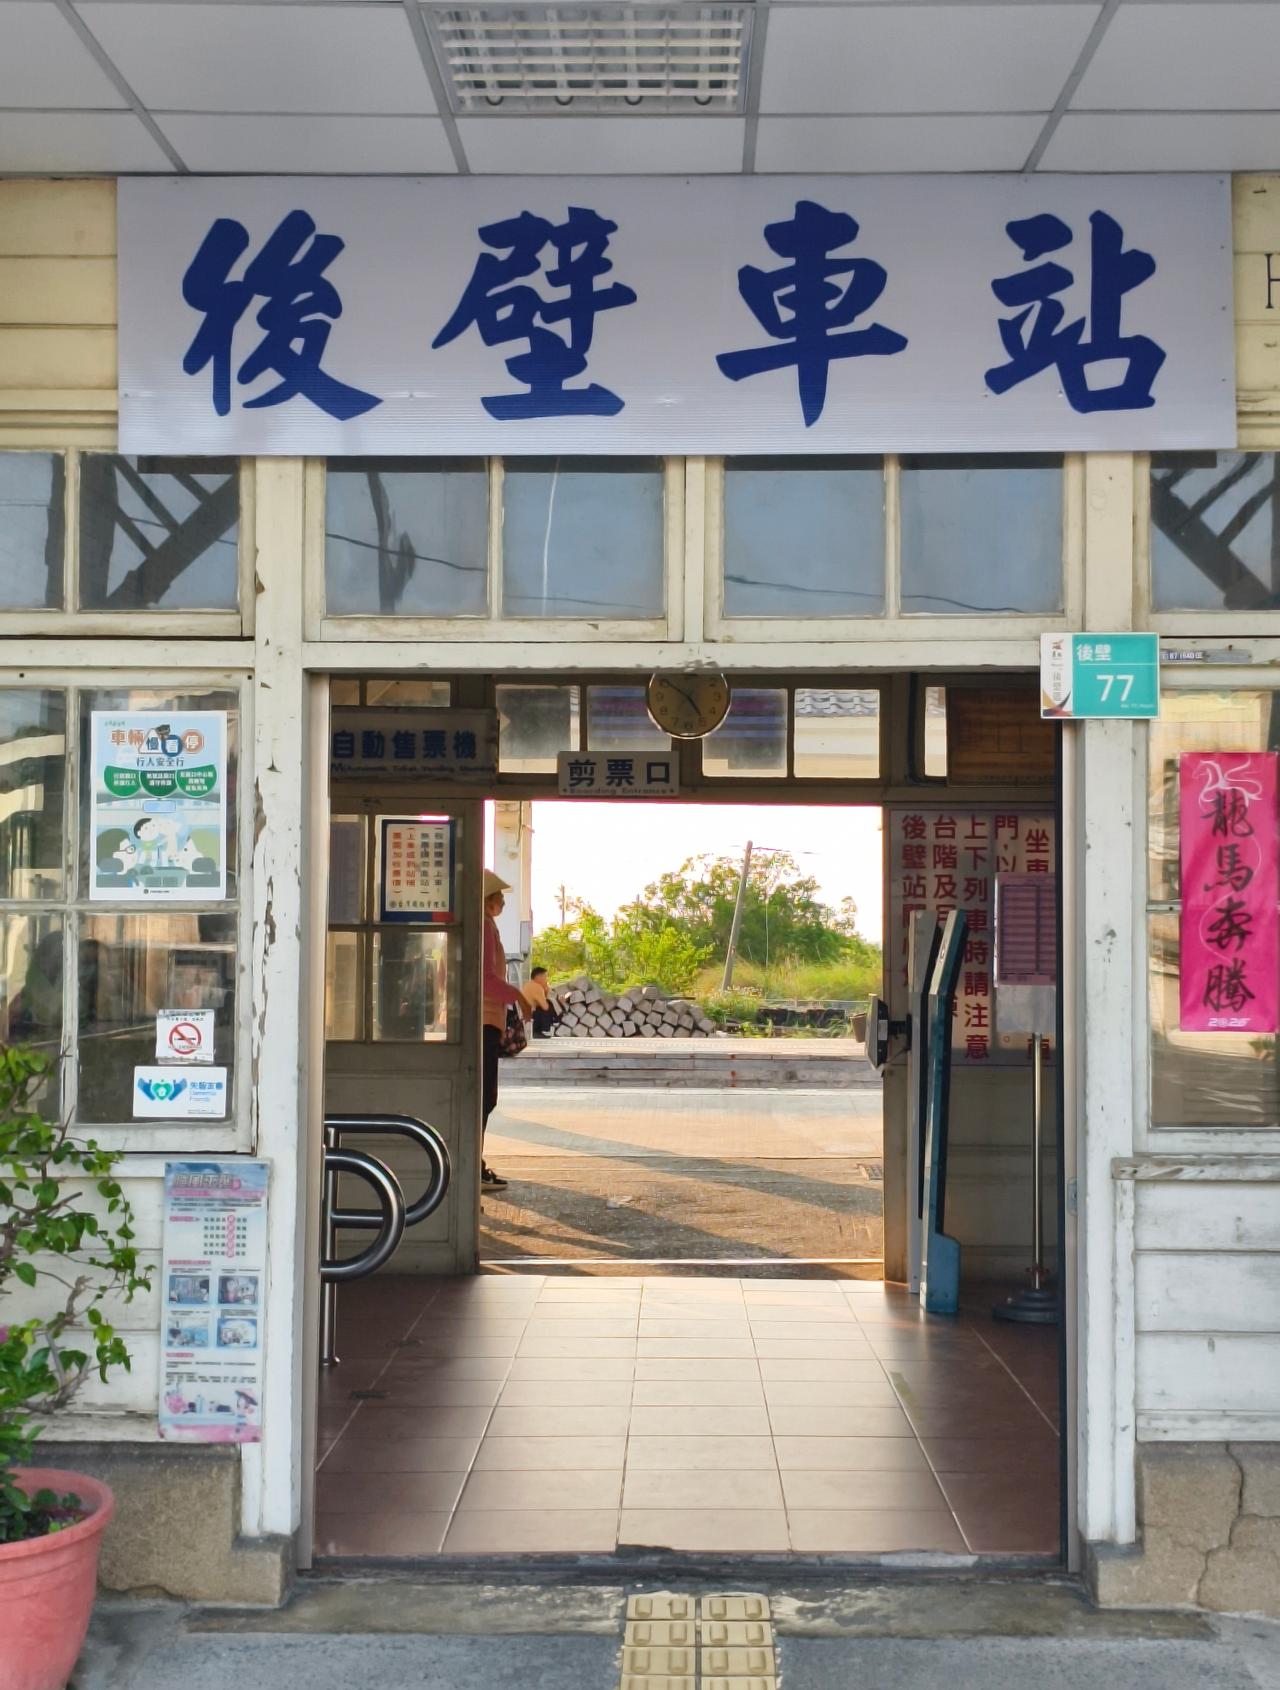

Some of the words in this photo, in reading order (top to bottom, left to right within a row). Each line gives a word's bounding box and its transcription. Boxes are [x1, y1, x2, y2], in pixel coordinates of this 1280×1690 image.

[182, 199, 1168, 428] 後壁車站
[1076, 644, 1111, 662] 後壁
[1096, 674, 1134, 702] 77
[332, 729, 477, 760] 自動售票機
[136, 757, 185, 768] 行人安全行
[567, 758, 670, 787] 剪票口
[1201, 788, 1255, 1012] 龍馬奔騰
[963, 814, 989, 1061] 上下列車時請注意
